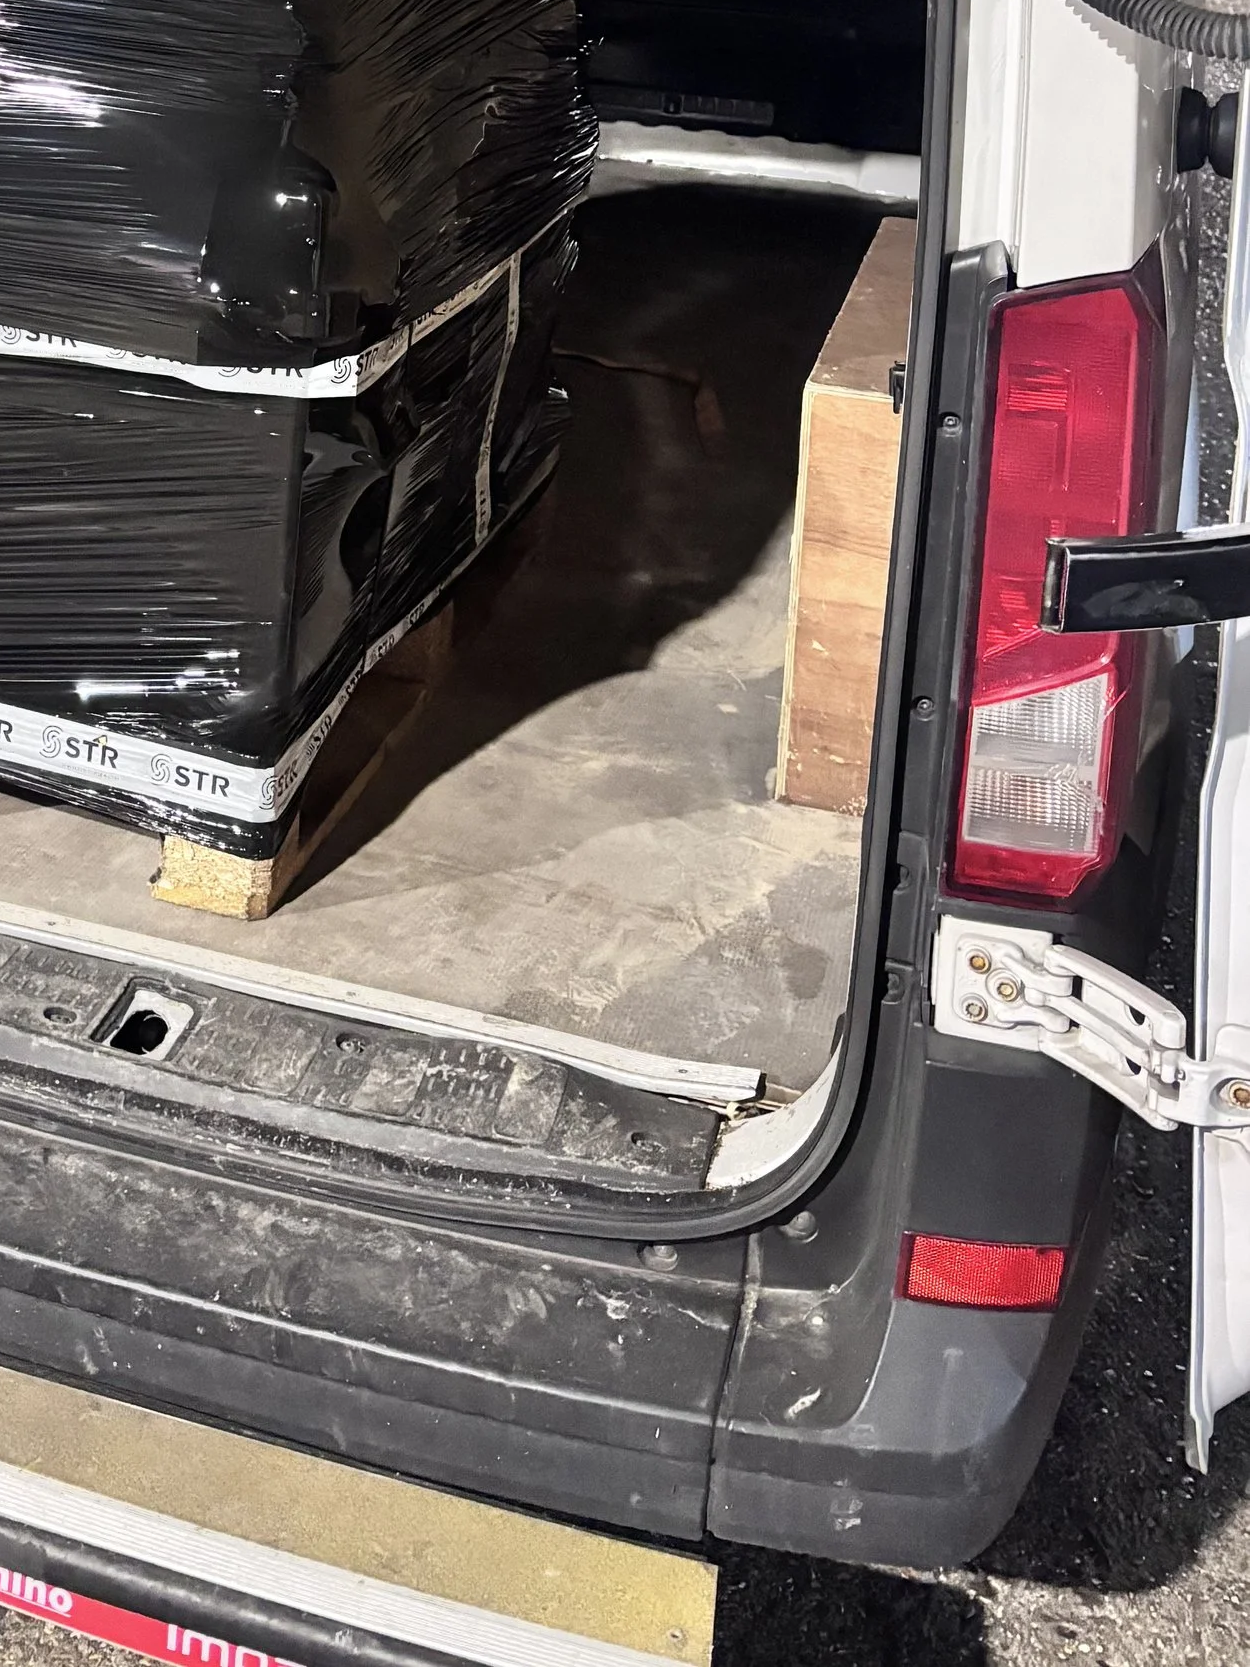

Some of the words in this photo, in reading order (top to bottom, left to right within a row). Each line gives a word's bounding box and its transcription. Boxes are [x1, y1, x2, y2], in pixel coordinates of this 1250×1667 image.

[355, 347, 379, 376] STR
[65, 736, 119, 769] STR
[175, 765, 230, 797] STR
